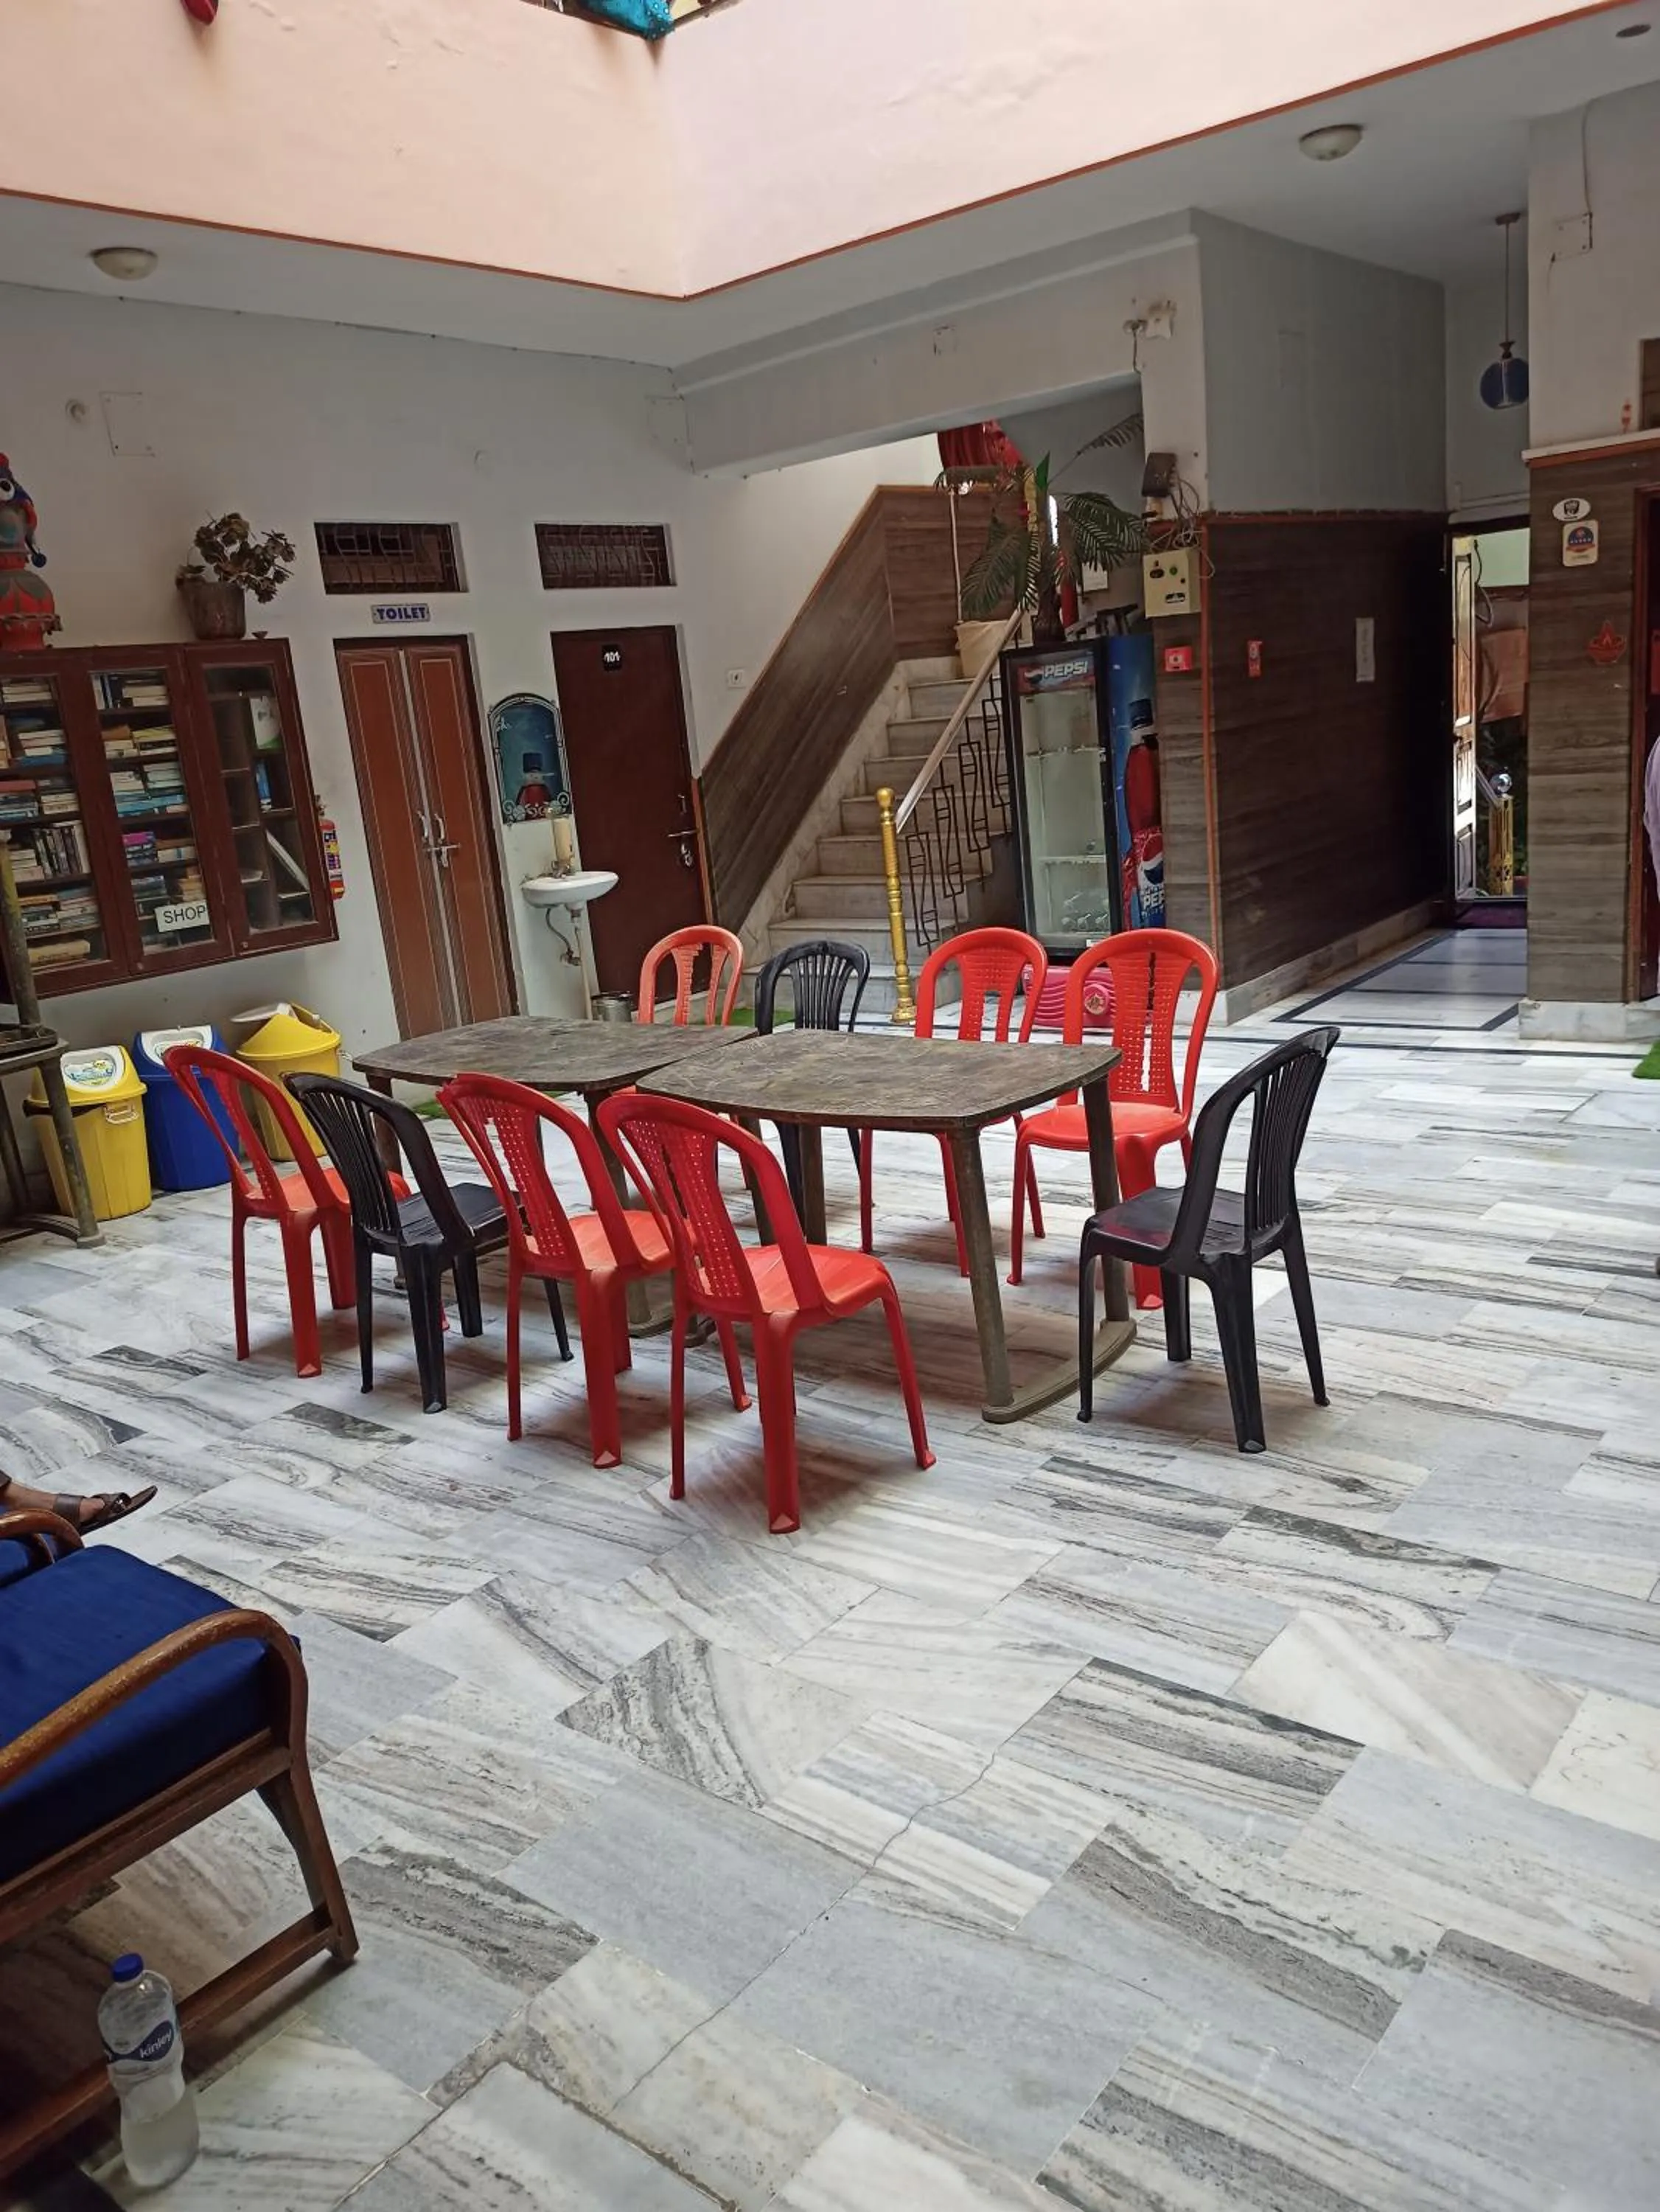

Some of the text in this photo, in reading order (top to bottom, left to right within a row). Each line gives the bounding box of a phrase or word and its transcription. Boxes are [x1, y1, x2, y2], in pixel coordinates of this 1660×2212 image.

[377, 607, 425, 620] TOILET
[1044, 661, 1088, 678] PEPSI
[164, 905, 206, 923] SHOP
